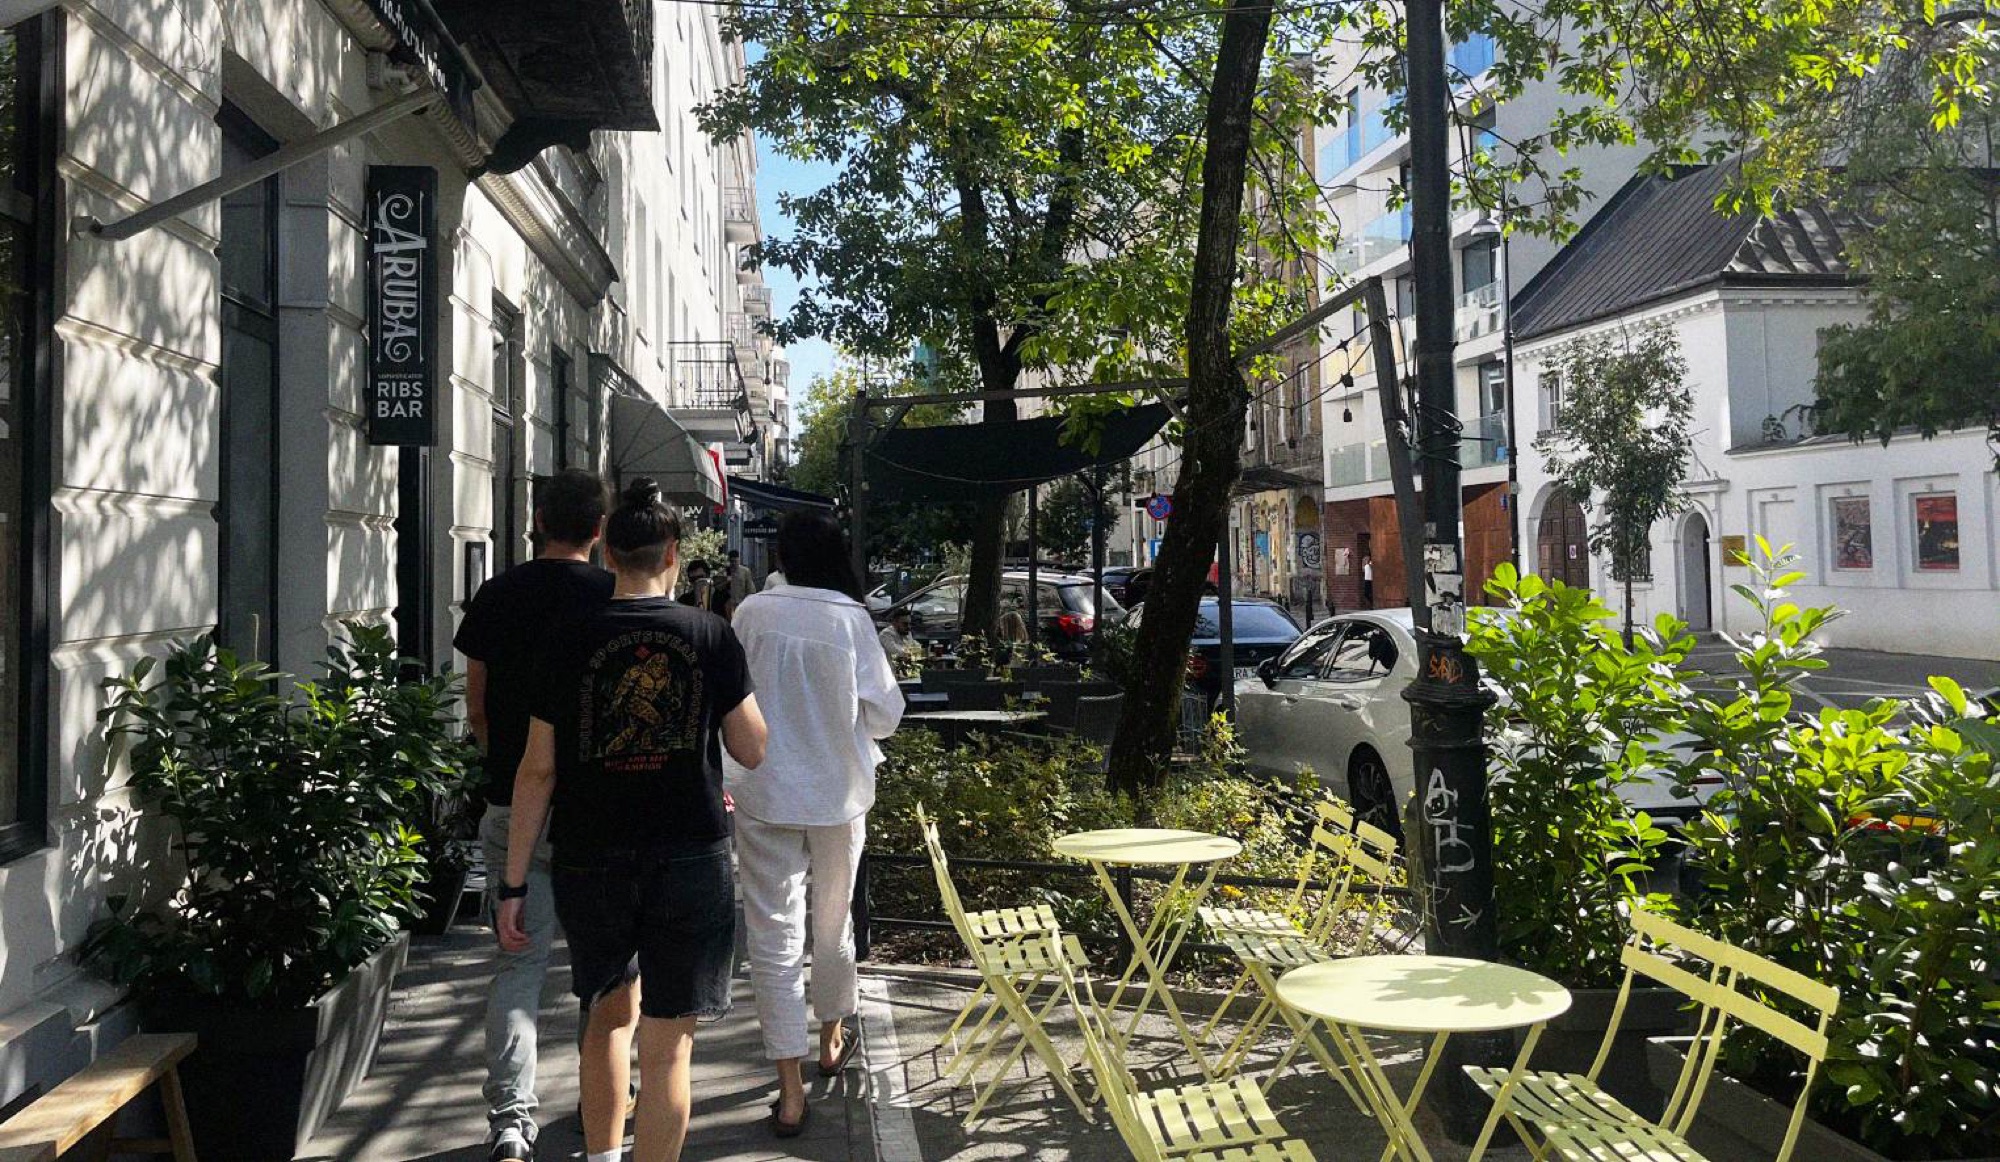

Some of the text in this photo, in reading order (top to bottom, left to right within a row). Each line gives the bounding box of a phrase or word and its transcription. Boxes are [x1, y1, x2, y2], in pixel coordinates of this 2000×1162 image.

[374, 194, 427, 362] ARUBA
[378, 382, 422, 397] RIBS
[378, 400, 422, 418] BAR
